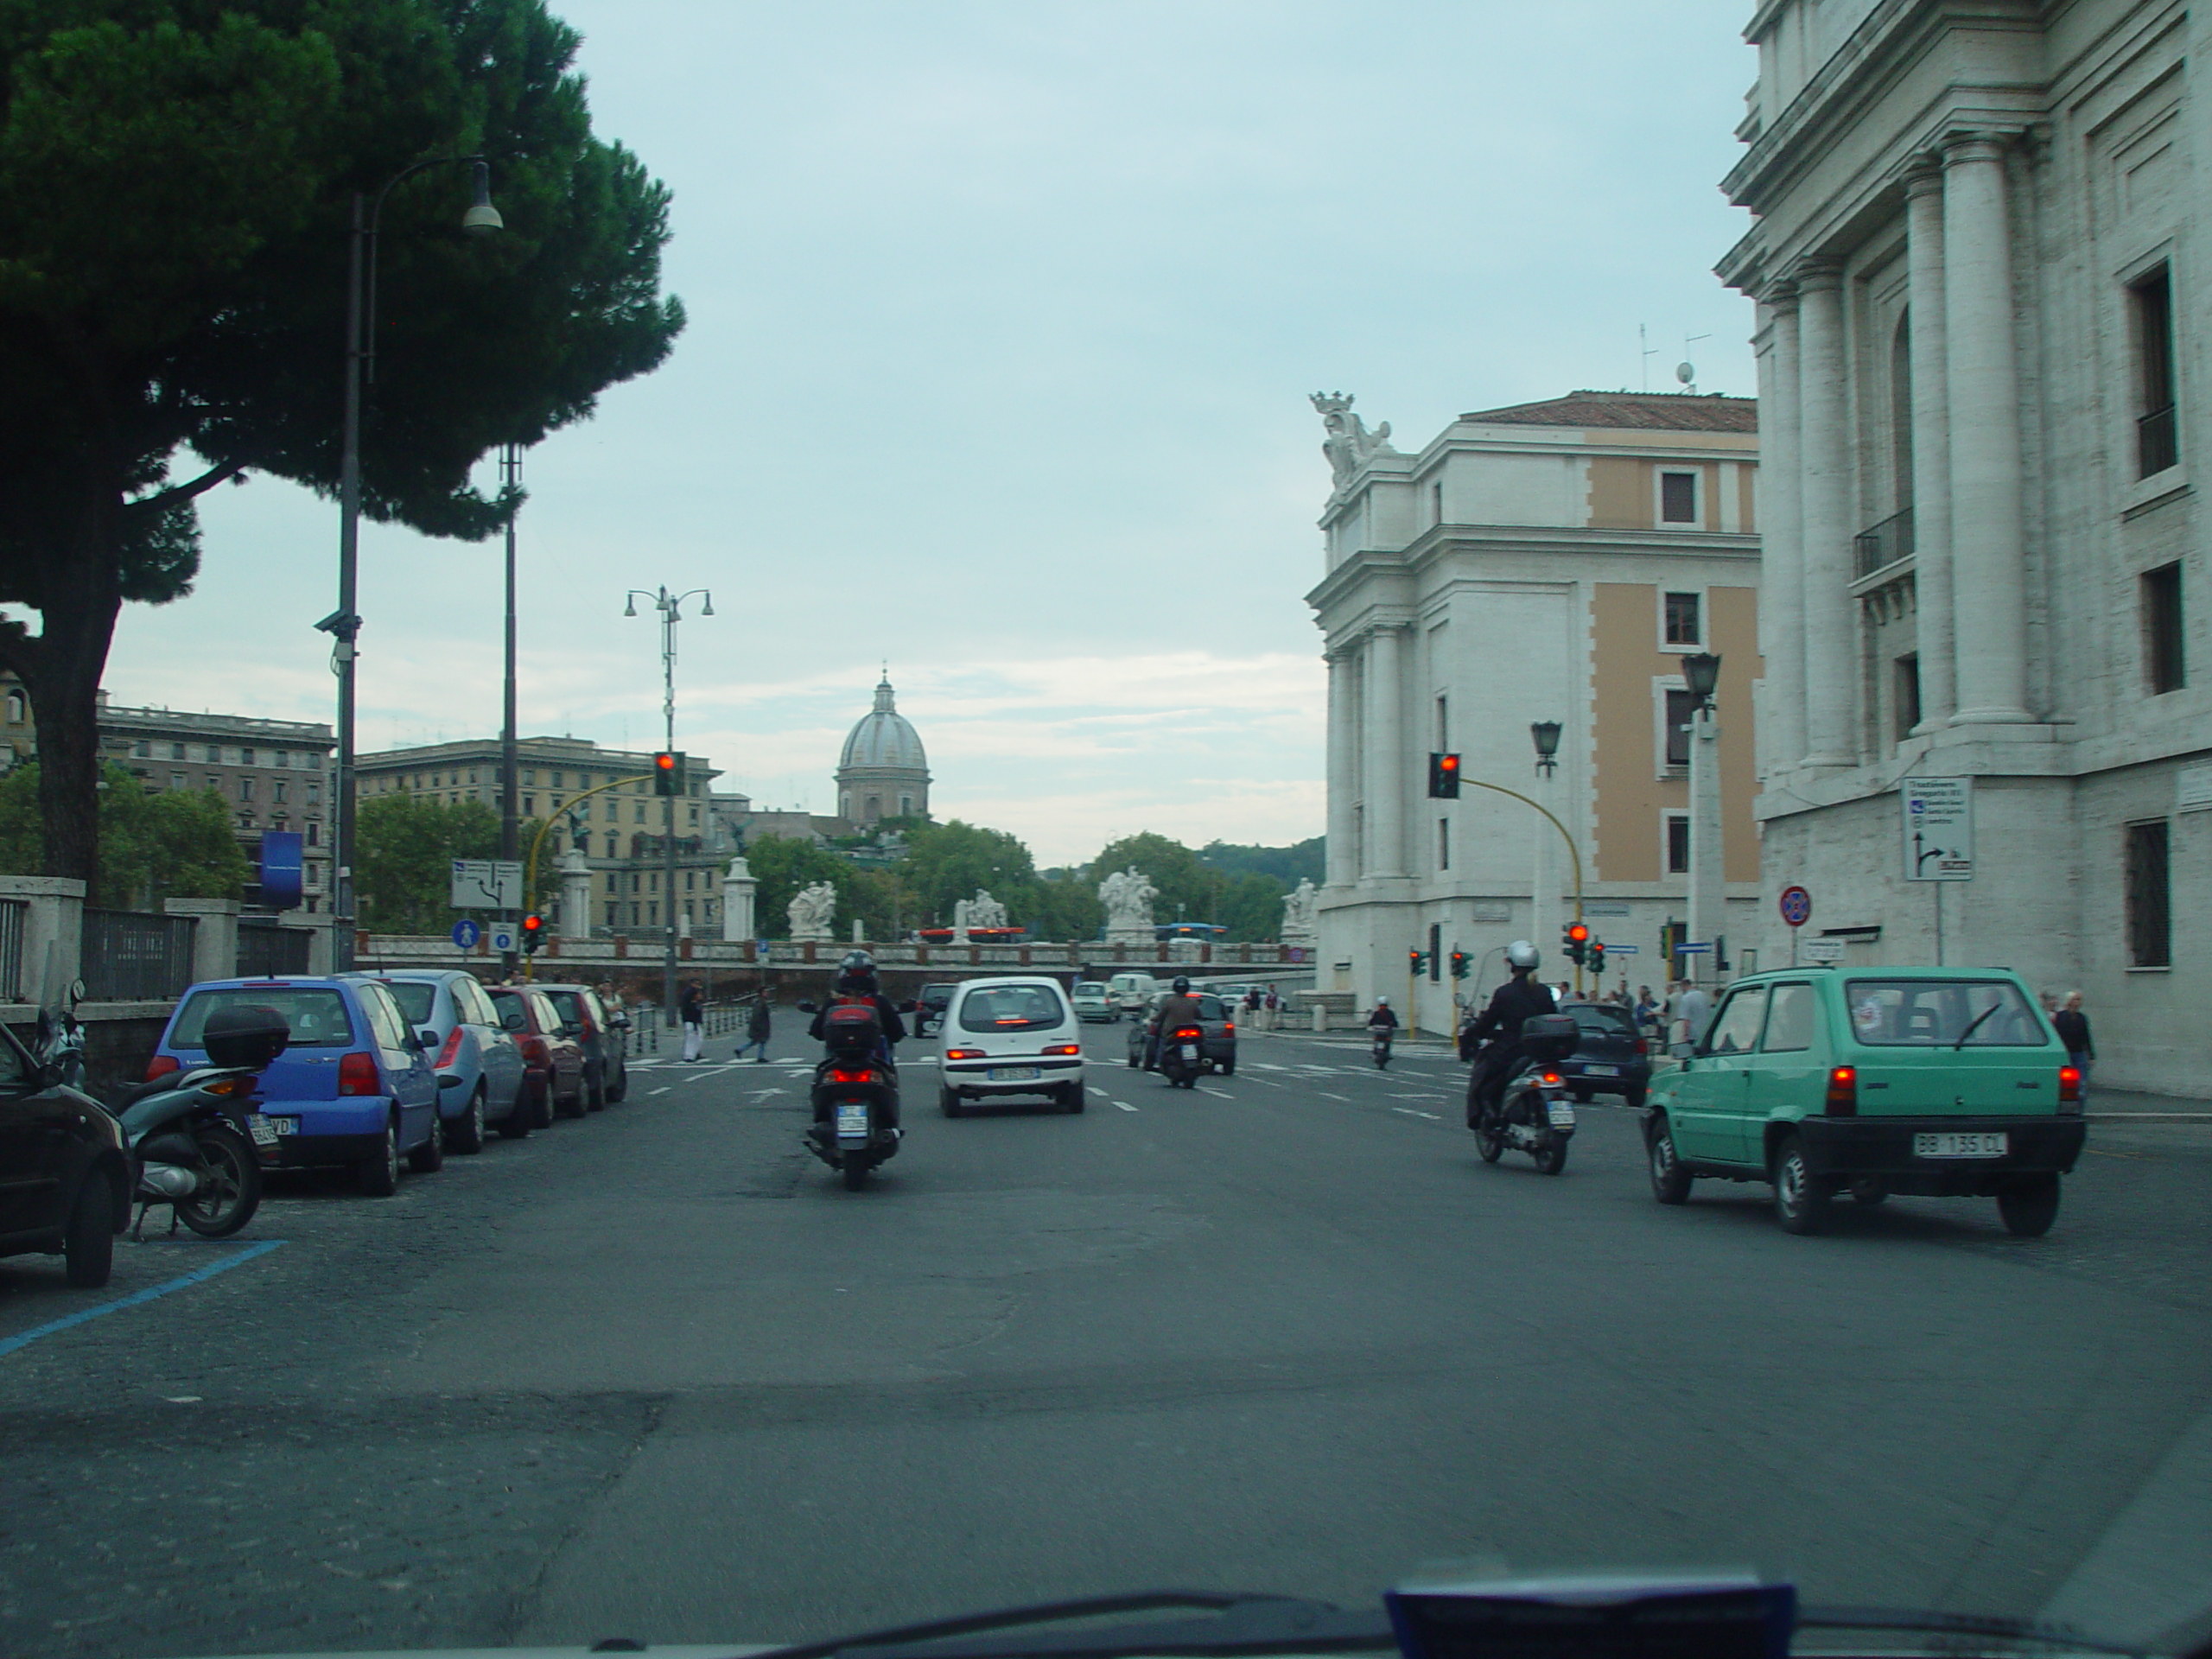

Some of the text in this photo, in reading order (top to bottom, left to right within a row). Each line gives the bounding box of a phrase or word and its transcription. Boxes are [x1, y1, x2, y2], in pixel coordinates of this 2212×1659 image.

[1919, 1135, 2004, 1153] BB 135 CL
